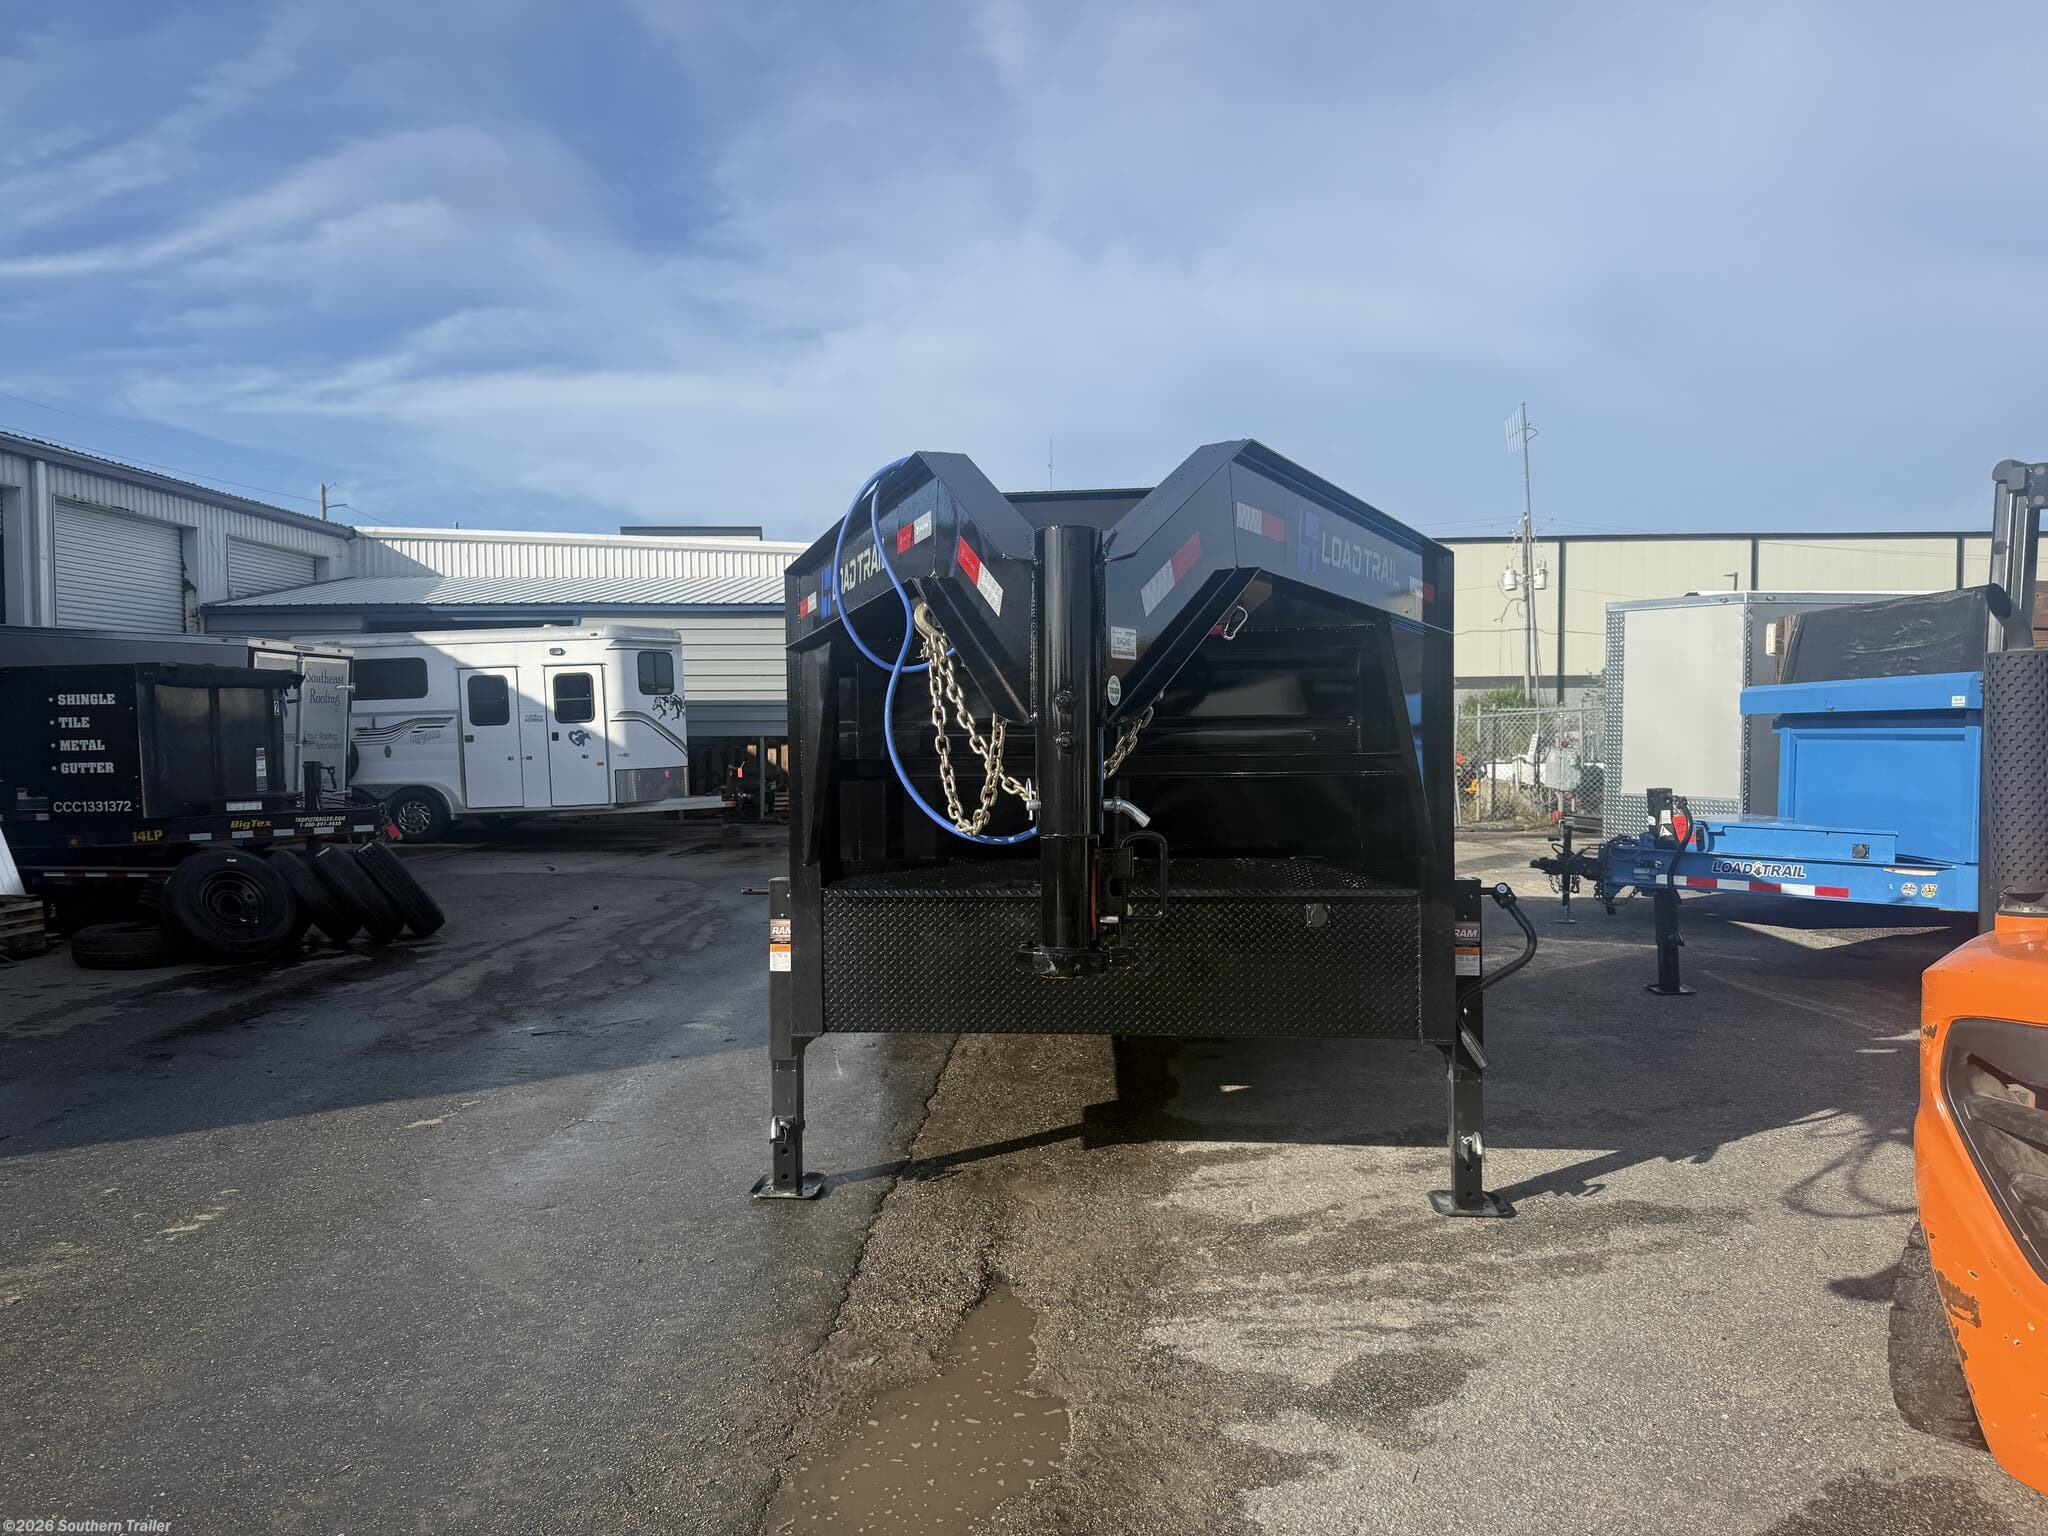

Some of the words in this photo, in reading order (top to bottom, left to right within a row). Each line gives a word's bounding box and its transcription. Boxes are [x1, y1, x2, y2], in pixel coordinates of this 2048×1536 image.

[1321, 531, 1362, 576] LOAD
[1363, 547, 1400, 588] TRAIL
[305, 667, 345, 685] Southeast
[57, 693, 116, 706] SHINGLE
[309, 688, 341, 707] Roofing
[58, 716, 90, 728] TILE
[60, 739, 106, 751] METAL
[60, 761, 115, 774] GUTTER
[53, 800, 132, 813] CCC1331372
[131, 829, 163, 842] 14LP
[1712, 860, 1753, 875] LOAD
[1761, 863, 1807, 879] TRAIL
